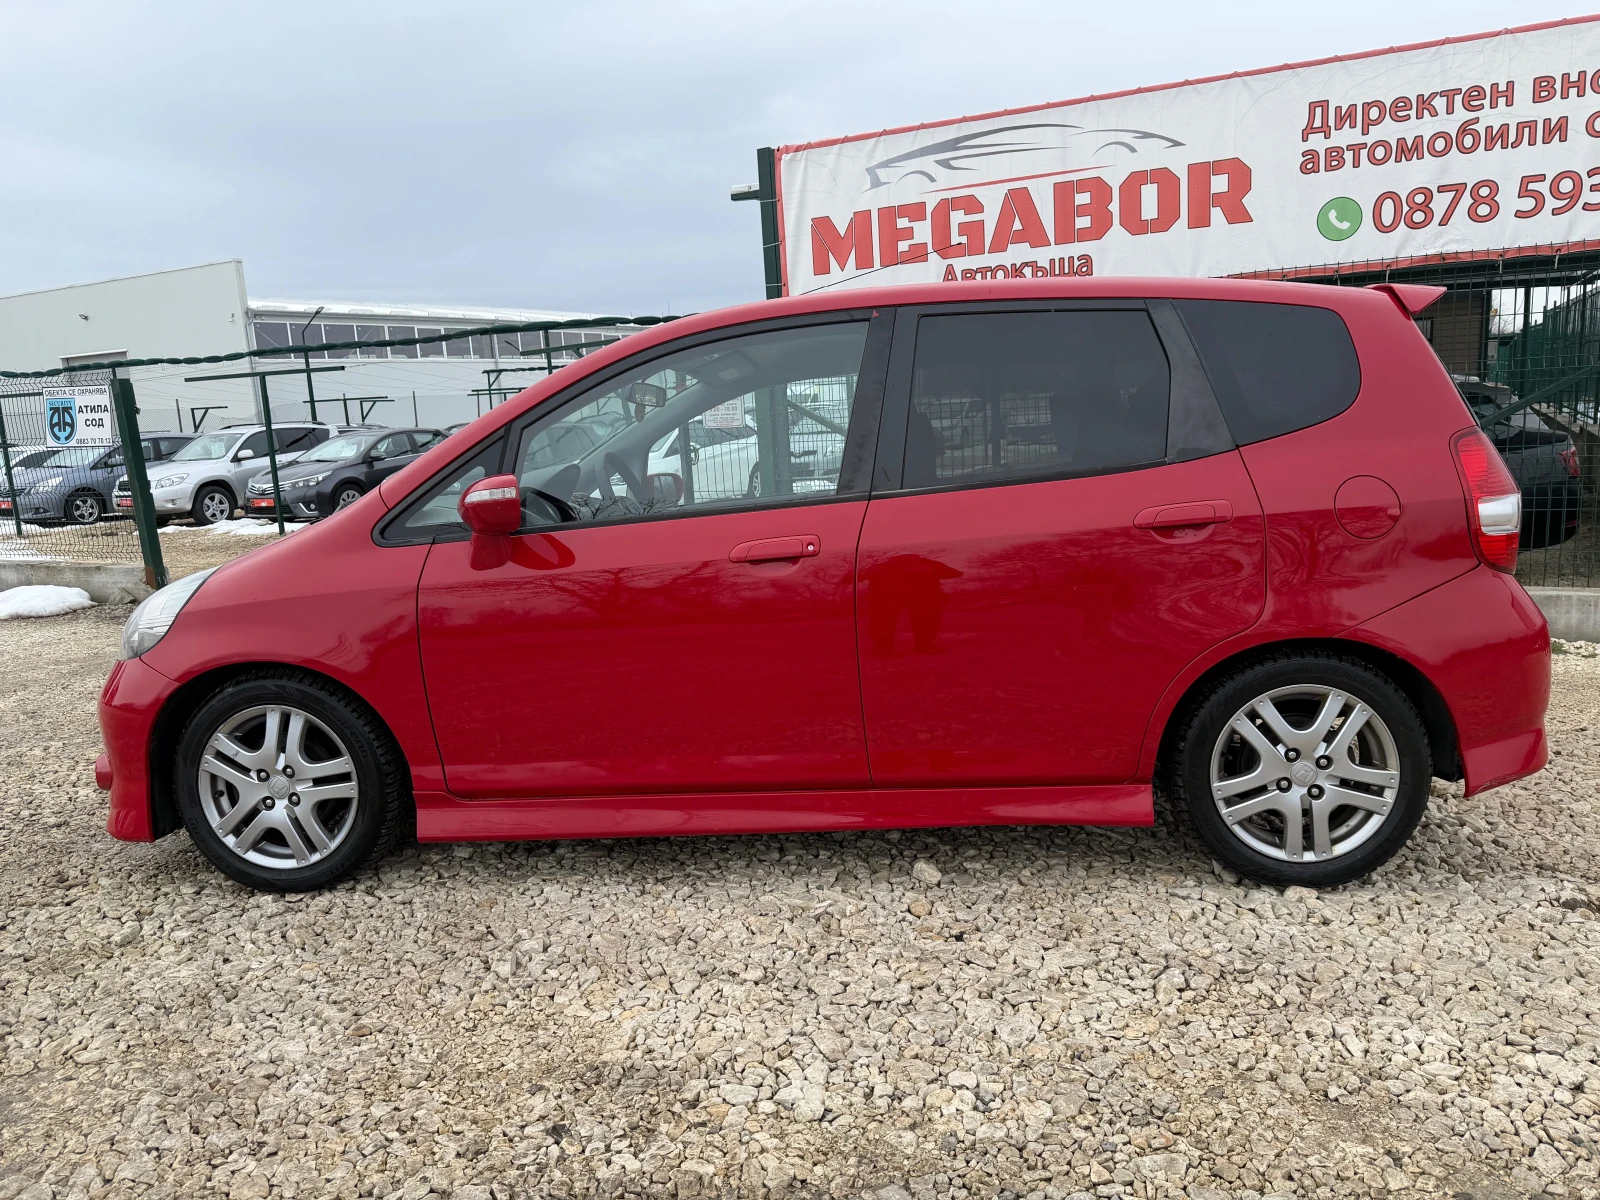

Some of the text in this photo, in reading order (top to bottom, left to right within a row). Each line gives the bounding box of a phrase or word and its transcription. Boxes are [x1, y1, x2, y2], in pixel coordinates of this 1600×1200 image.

[1302, 80, 1515, 142] Директен
[1300, 115, 1569, 174] автомобили
[810, 157, 1253, 276] MEGABOR
[1372, 166, 1600, 233] 0878 593
[78, 404, 109, 414] АТИЛА
[85, 418, 104, 428] СОД
